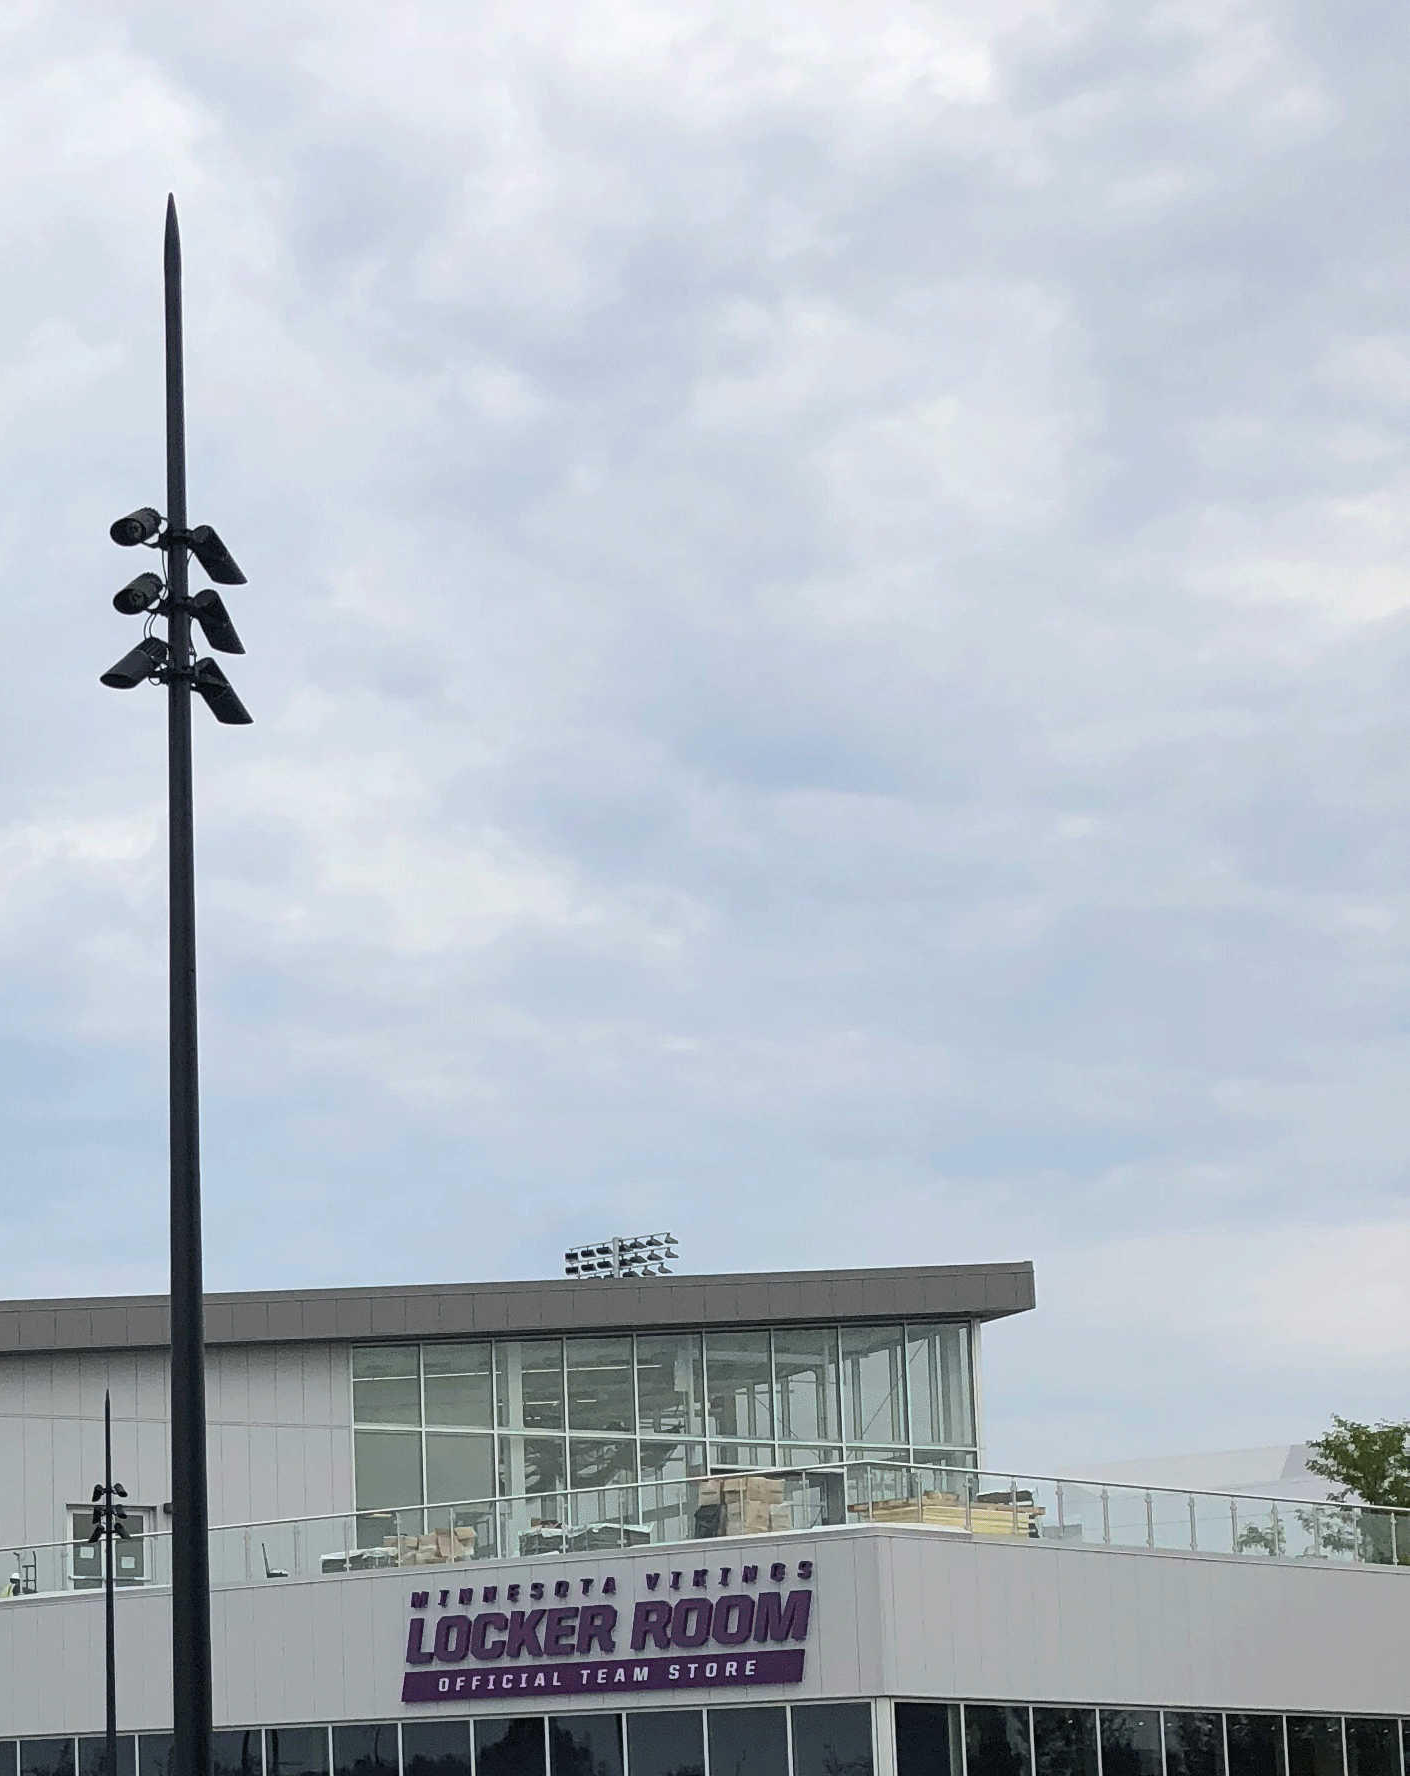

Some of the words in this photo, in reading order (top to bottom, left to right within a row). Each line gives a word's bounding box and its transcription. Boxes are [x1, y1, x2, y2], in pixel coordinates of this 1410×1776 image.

[410, 1576, 617, 1609] MINNESOTA
[645, 1560, 813, 1591] VIKINGS
[405, 1604, 618, 1664] LOCKER
[630, 1589, 813, 1650] ROOM
[438, 1671, 562, 1692] OFFICIAL
[580, 1666, 649, 1685] TEAM
[668, 1659, 757, 1680] STORE
